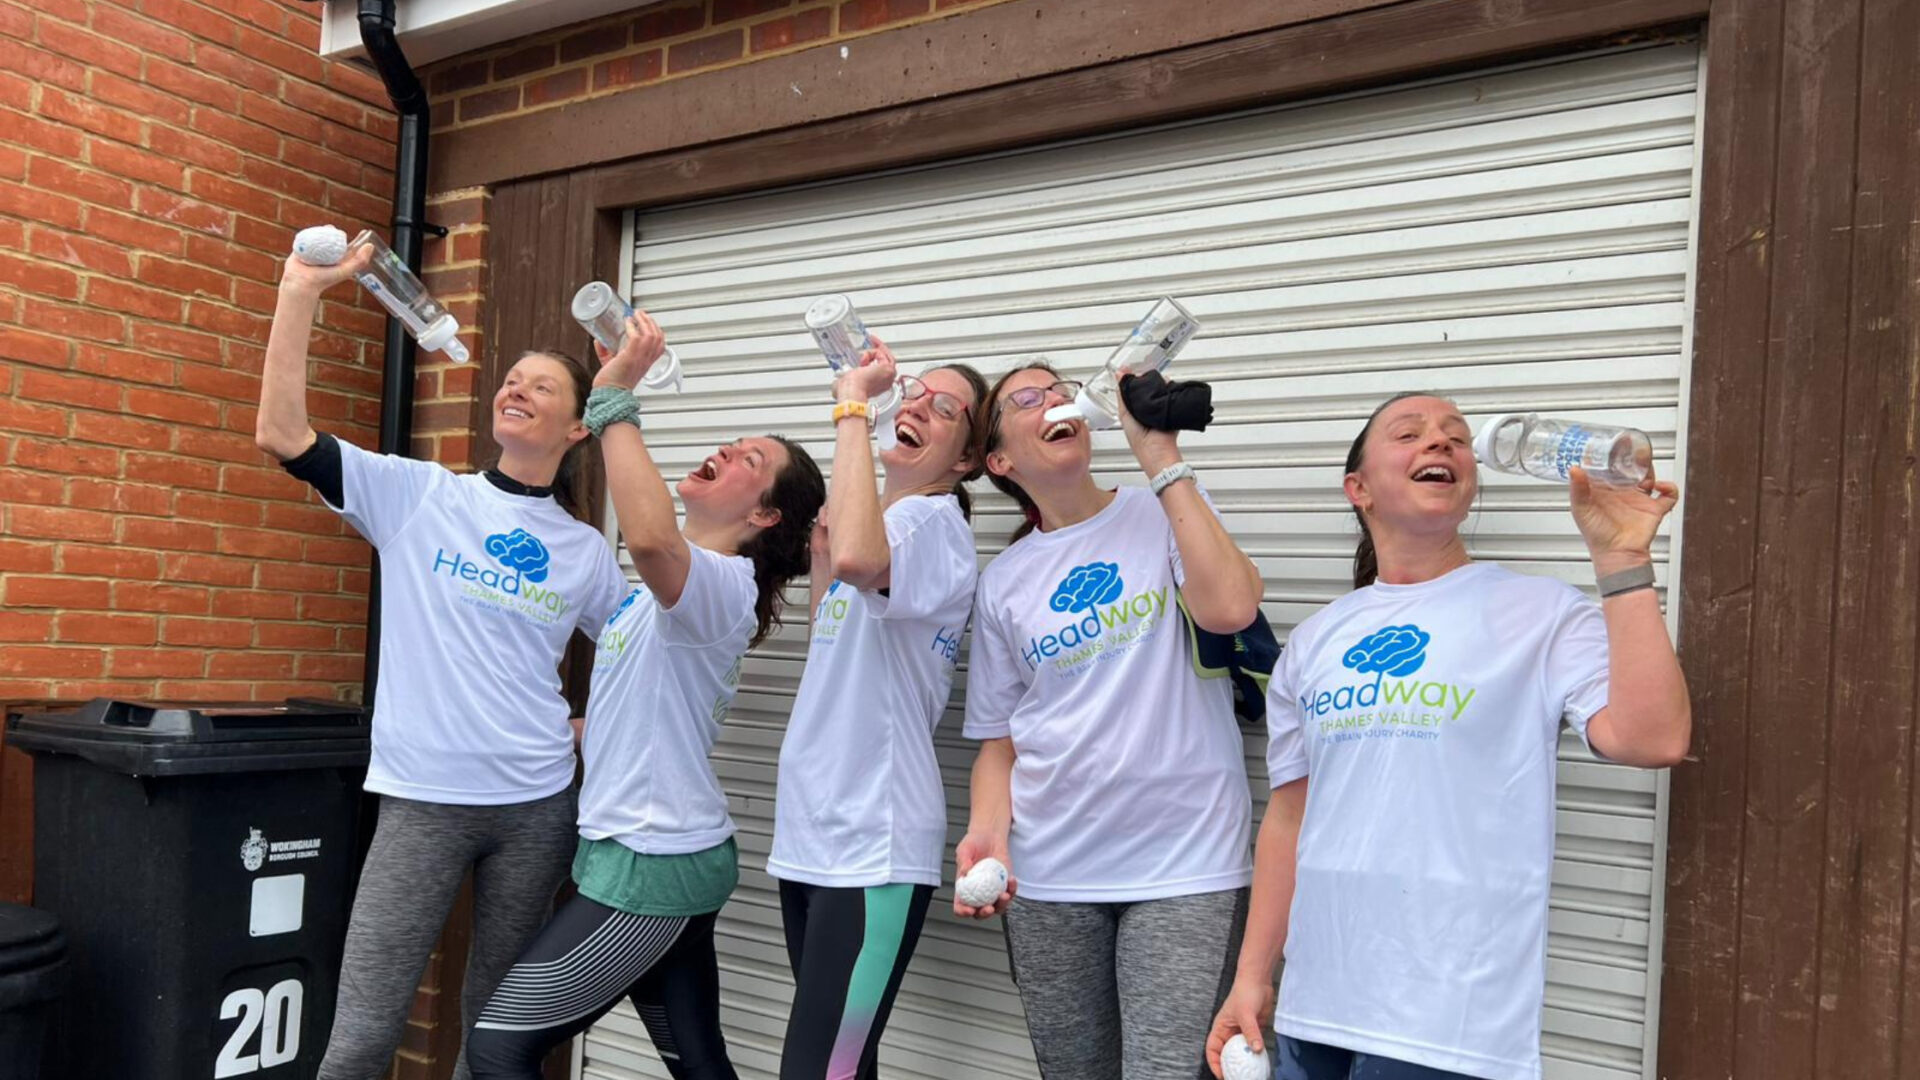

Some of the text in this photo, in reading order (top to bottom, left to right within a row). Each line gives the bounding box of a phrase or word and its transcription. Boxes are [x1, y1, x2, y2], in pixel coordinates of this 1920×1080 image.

[433, 548, 571, 622] Headway
[463, 583, 514, 606] THAMES
[1021, 586, 1168, 672] Headway
[1056, 619, 1156, 670] THAMES VALLEY
[1300, 677, 1476, 721] Headway
[1320, 711, 1443, 734] THAMES VALLEY
[1364, 728, 1395, 739] JURY
[1395, 728, 1440, 742] CHARITY
[270, 838, 321, 853] WOKINGHAM
[214, 979, 304, 1080] 20
